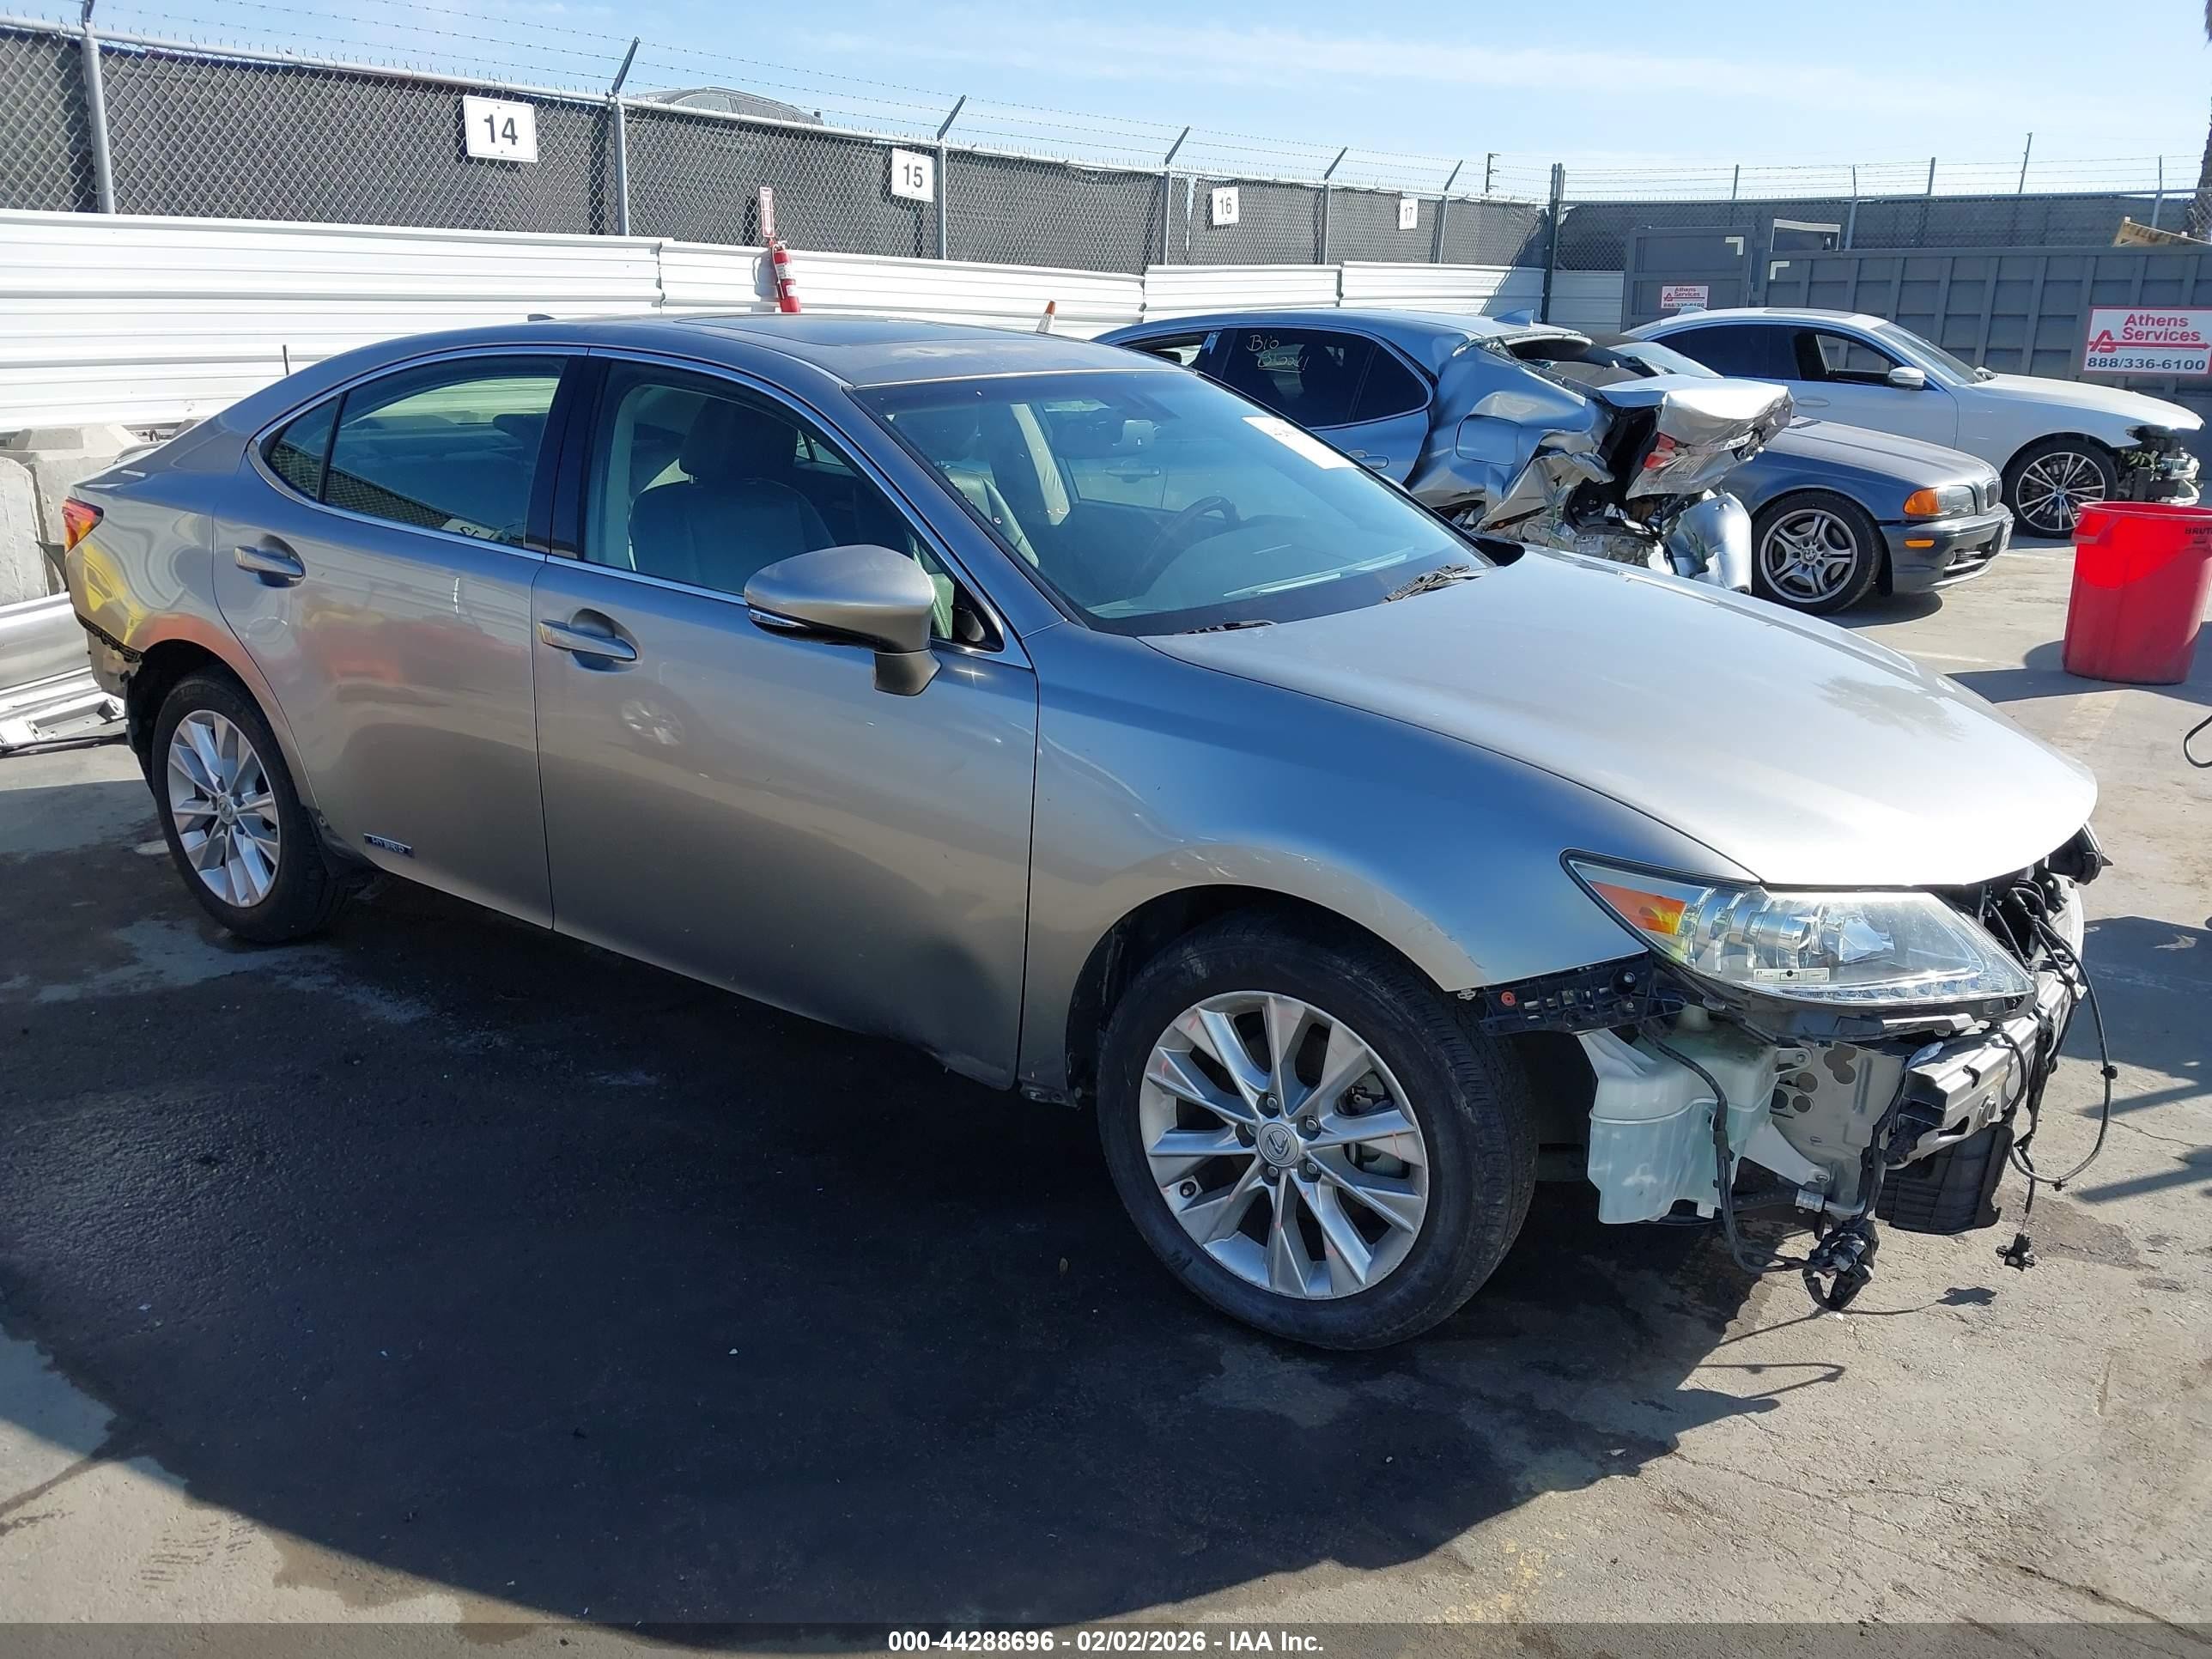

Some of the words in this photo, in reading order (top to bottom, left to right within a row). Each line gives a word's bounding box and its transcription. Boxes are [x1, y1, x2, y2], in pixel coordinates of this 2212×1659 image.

[483, 114, 519, 146] 14
[902, 163, 923, 188] 15
[1219, 197, 1232, 215] 16
[1405, 207, 1413, 222] 17
[2124, 313, 2189, 327] Athens
[2122, 327, 2201, 342] Services
[1246, 334, 1279, 352] Bio
[2087, 357, 2206, 370] 888/336-6100
